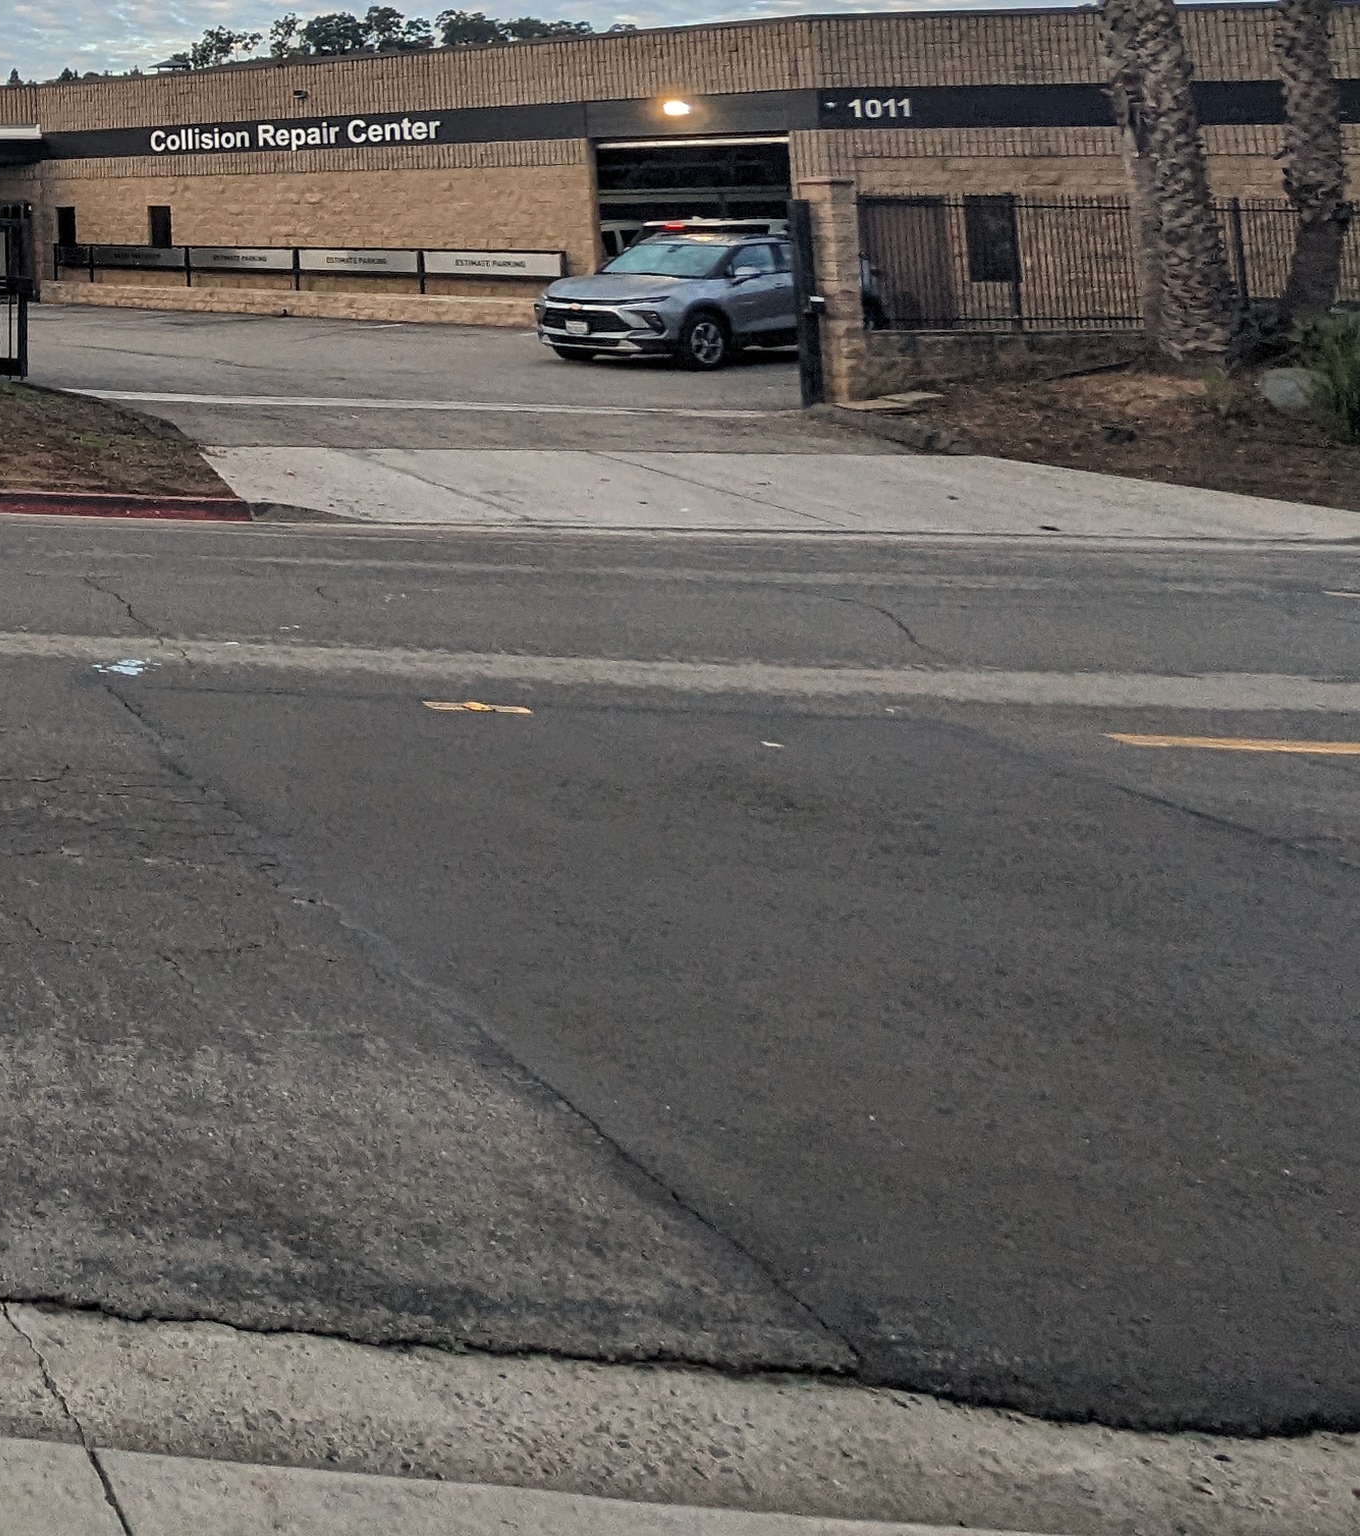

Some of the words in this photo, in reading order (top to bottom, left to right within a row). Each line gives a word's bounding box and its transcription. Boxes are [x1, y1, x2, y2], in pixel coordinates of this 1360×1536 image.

[847, 97, 912, 119] 1011
[149, 128, 250, 151] Collision
[257, 122, 340, 151] Repair
[347, 117, 441, 143] Center
